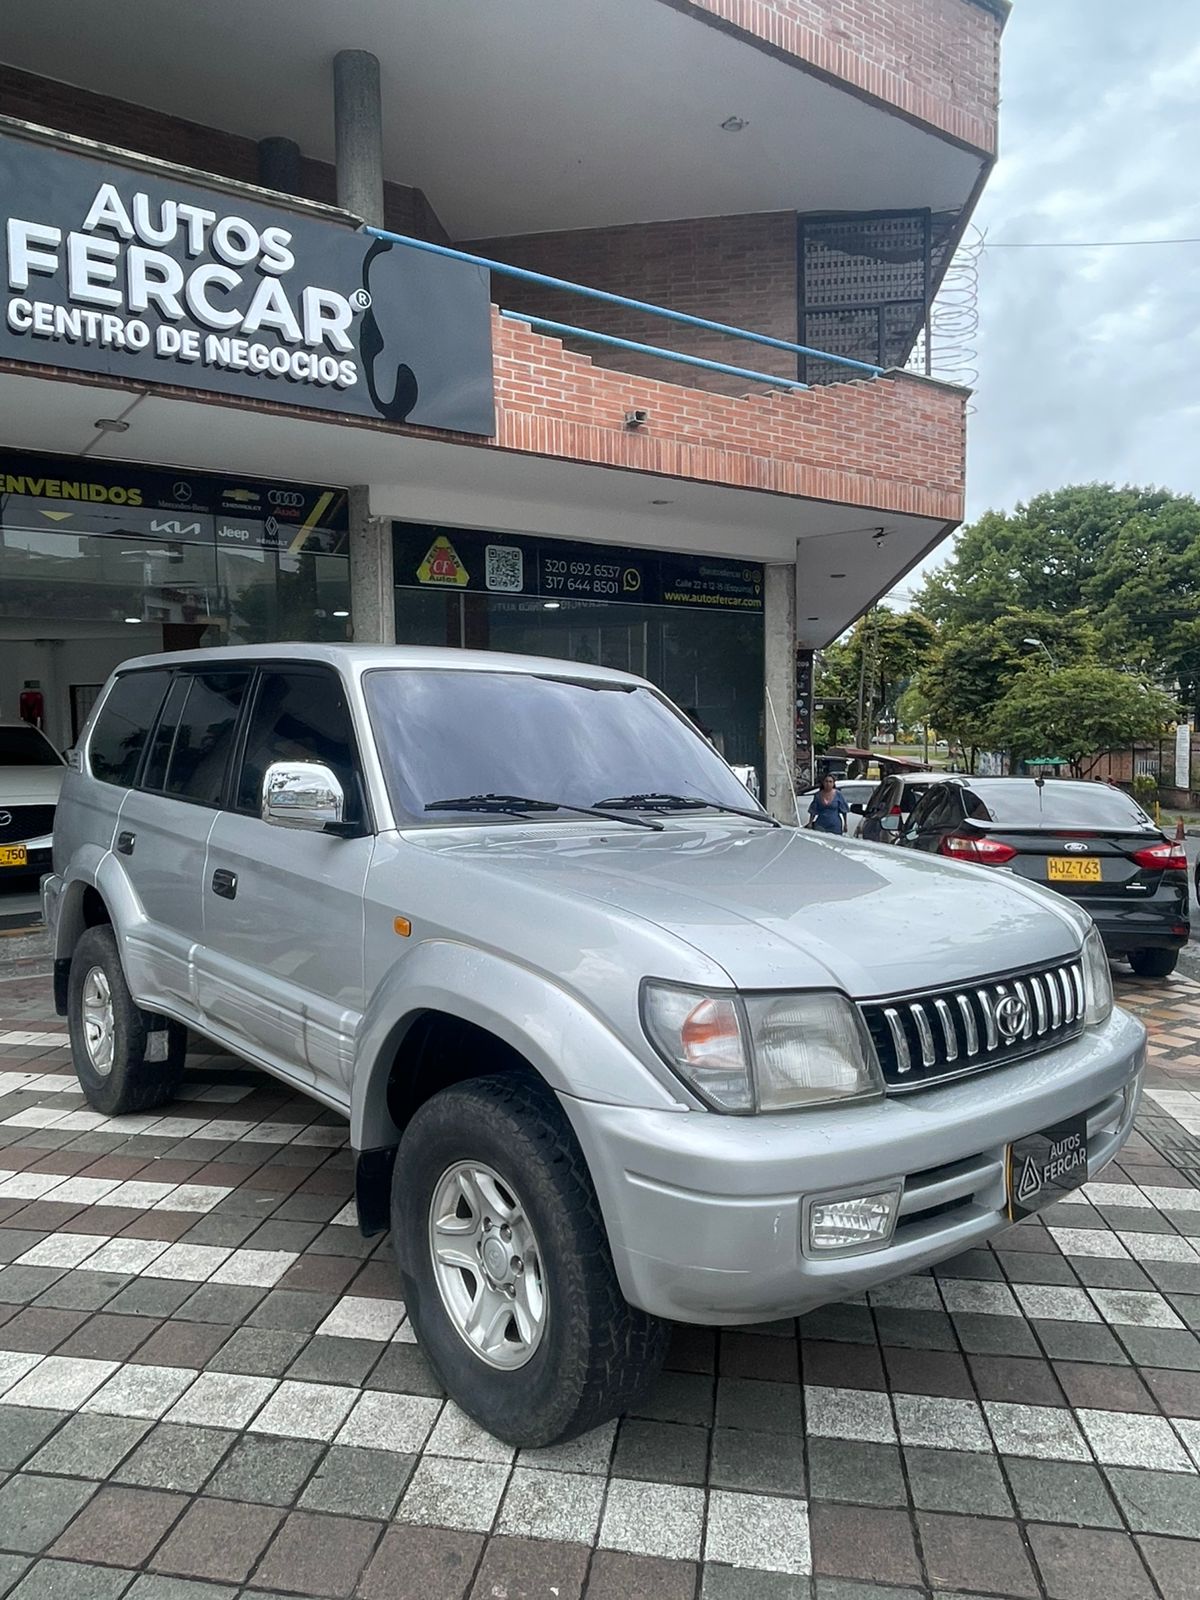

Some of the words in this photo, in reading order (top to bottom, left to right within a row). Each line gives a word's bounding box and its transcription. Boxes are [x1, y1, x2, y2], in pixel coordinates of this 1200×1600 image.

[82, 183, 295, 275] AUTOS
[7, 218, 356, 353] FERCAR
[7, 298, 150, 350] CENTRO
[156, 324, 201, 362] DE
[205, 336, 358, 388] NEGOCIOS
[151, 519, 200, 535] KIA
[218, 526, 250, 541] Jeep
[545, 560, 567, 573] 320
[570, 562, 591, 576] 692
[594, 565, 620, 578] 6537
[545, 576, 564, 589] 317
[567, 578, 591, 591] 644
[593, 580, 619, 594] 8501
[664, 592, 762, 608] www.autosfercar.com
[1050, 1133, 1080, 1159] AUTOS
[1043, 1148, 1086, 1183] FERCAR
